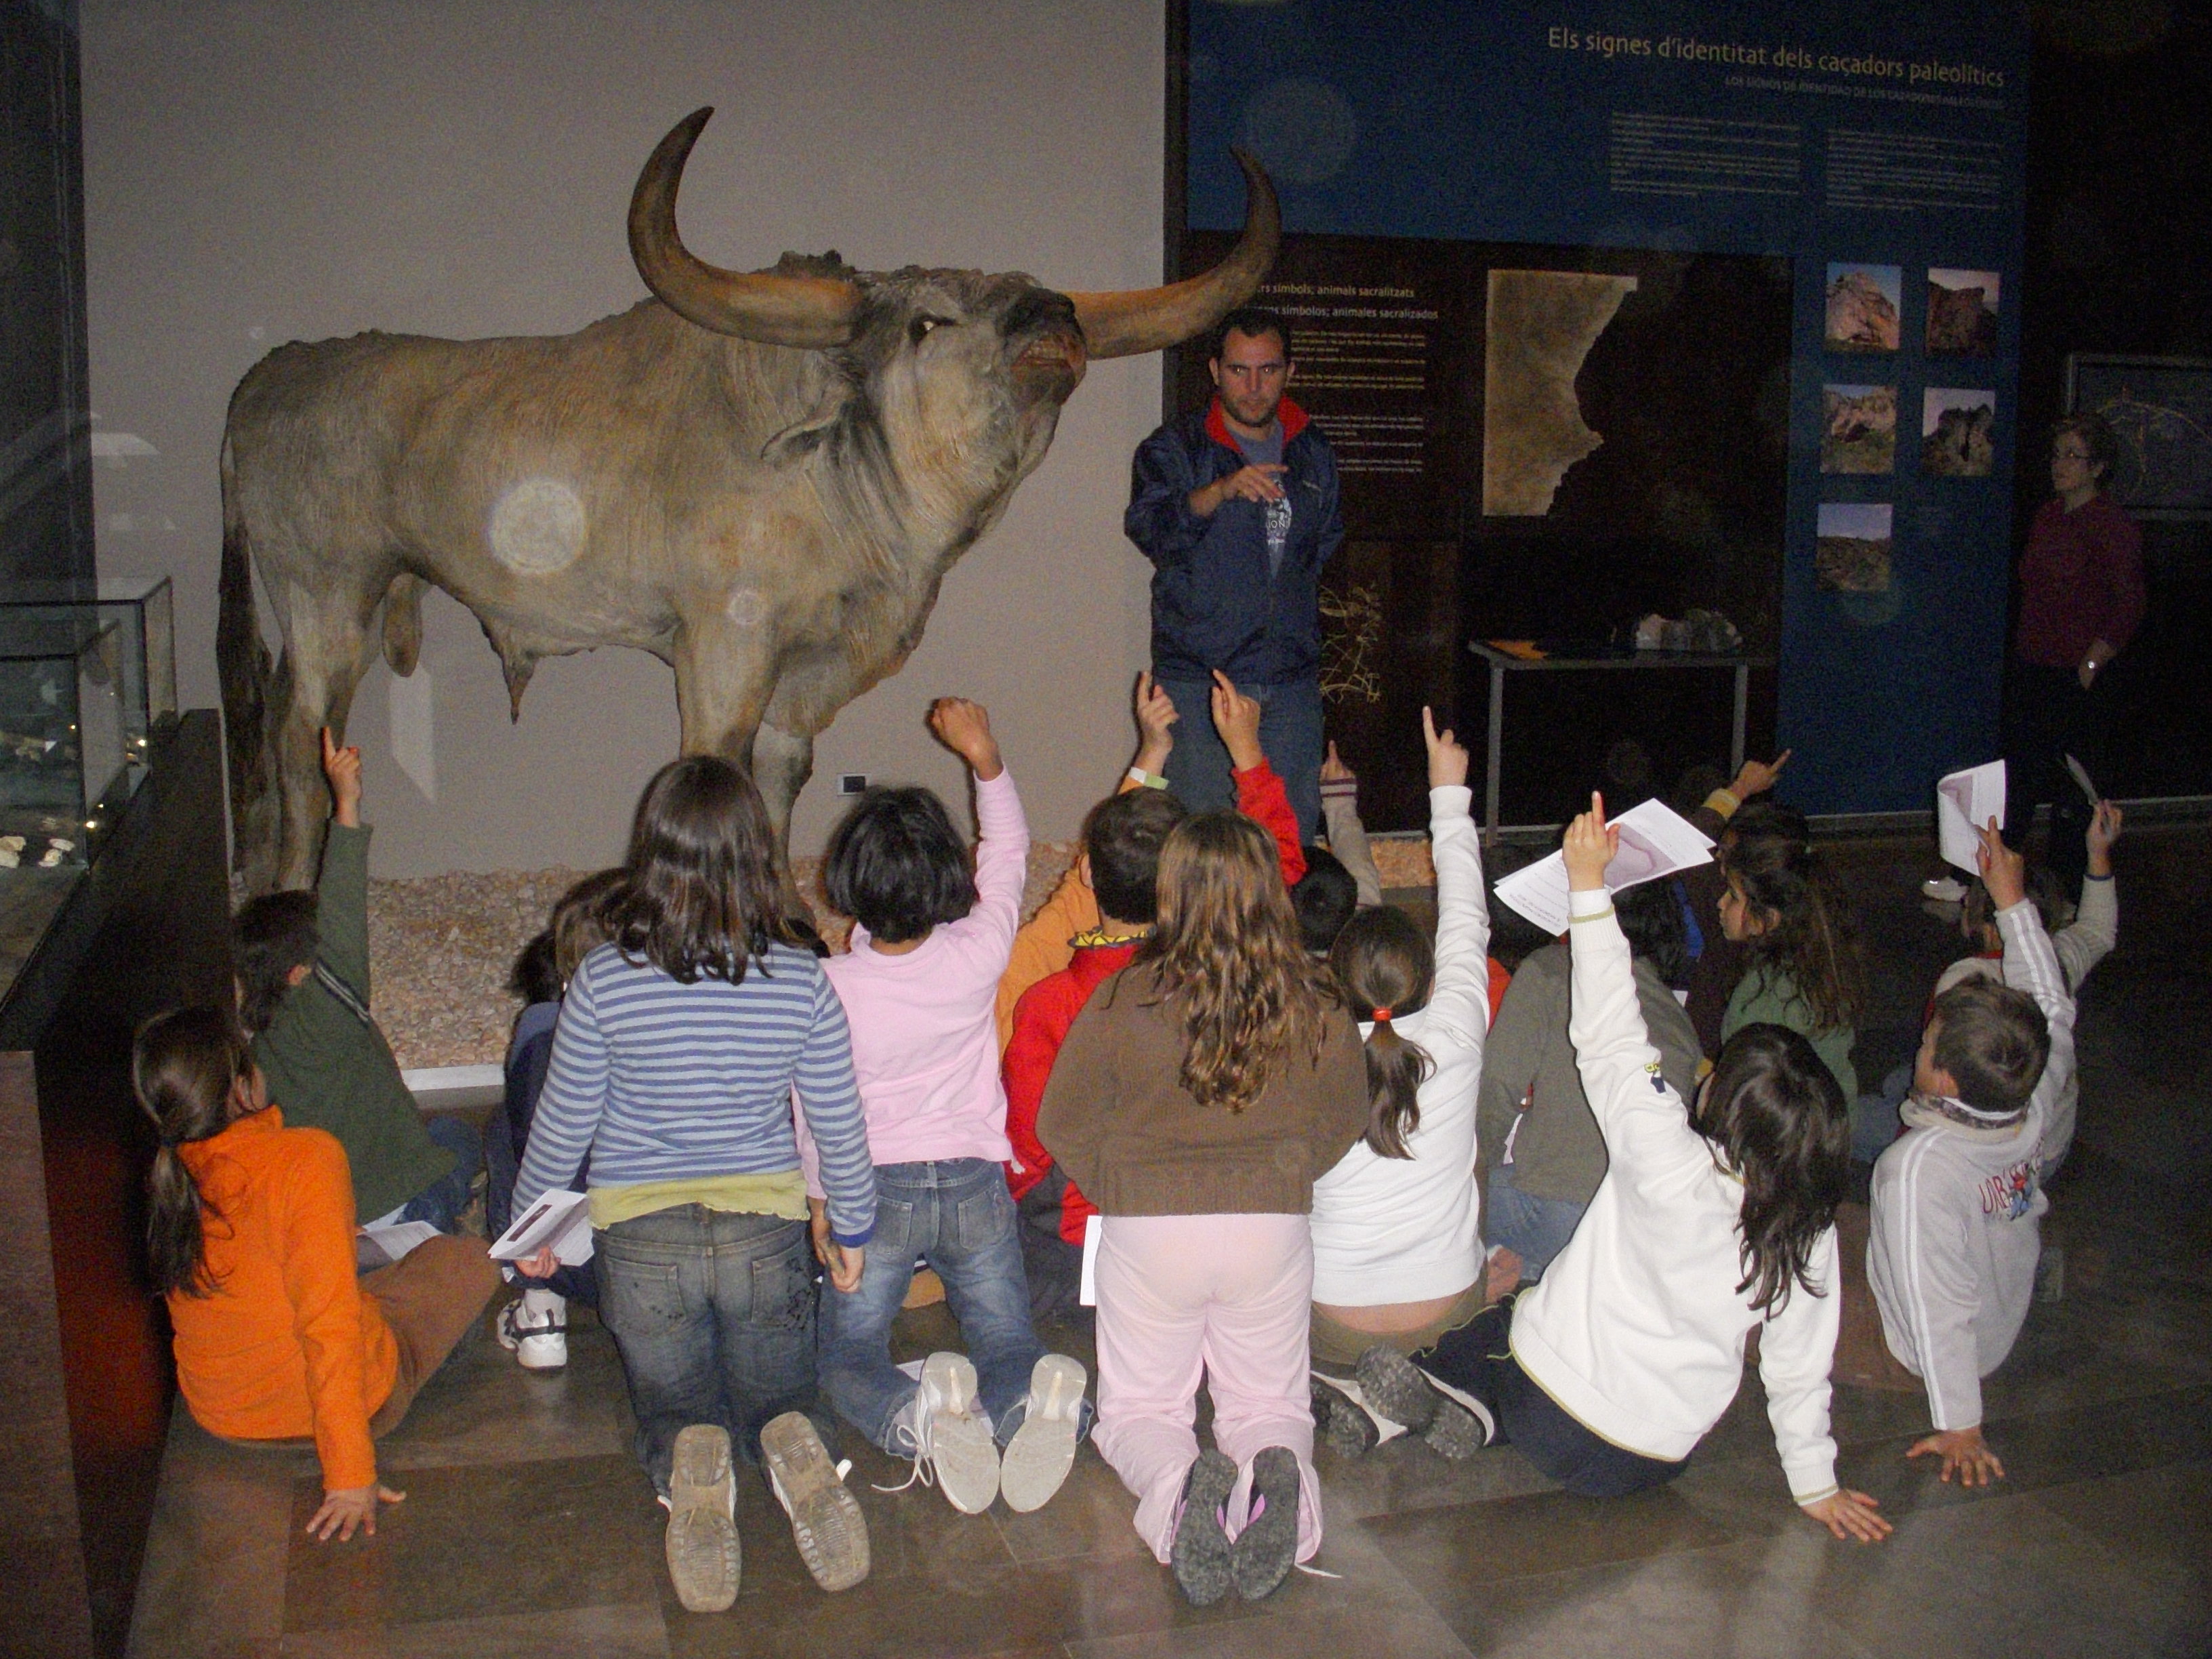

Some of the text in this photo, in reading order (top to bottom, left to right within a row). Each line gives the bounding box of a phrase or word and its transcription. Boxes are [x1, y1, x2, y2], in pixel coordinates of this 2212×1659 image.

[1549, 26, 1579, 49] Els
[1586, 31, 1652, 58] signes
[1658, 35, 1767, 65] d'identitat
[1773, 45, 1813, 69] dels
[1818, 54, 1904, 77] caçadors
[1317, 285, 1356, 296] animals
[1359, 287, 1414, 298] sacralitzats
[1332, 307, 1376, 318] animales
[1379, 308, 1438, 320] sacralizados
